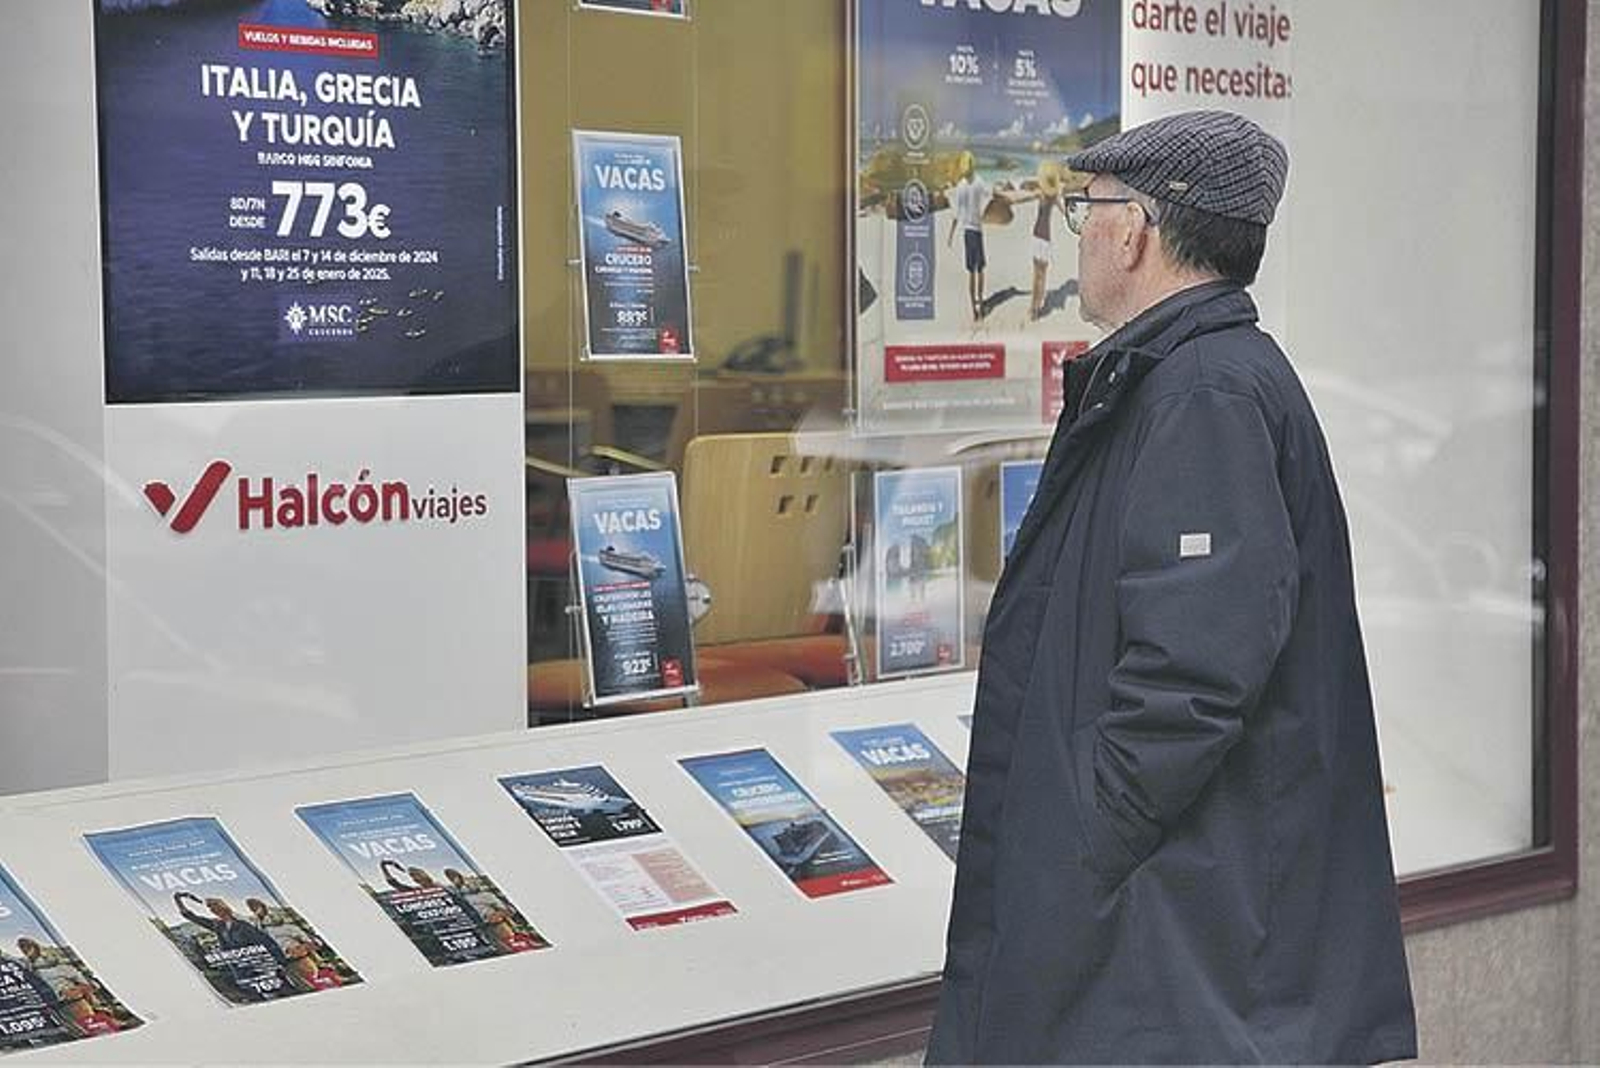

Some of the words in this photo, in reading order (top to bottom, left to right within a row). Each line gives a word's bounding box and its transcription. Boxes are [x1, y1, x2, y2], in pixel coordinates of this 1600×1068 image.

[1131, 0, 1197, 33] darte
[1205, 2, 1226, 37] el
[1234, 4, 1291, 47] viaje
[949, 54, 979, 75] 10%
[1014, 58, 1037, 78] 5%
[201, 64, 308, 107] ITALIA,
[314, 71, 422, 108] GRECIA
[1131, 62, 1178, 97] que
[232, 110, 254, 142] Y
[261, 110, 395, 149] TURQUÍA
[594, 163, 666, 191] VACAS
[229, 215, 266, 229] DESDE
[190, 247, 228, 262] Salidas
[230, 248, 263, 262] desde
[291, 249, 301, 262] el
[302, 250, 310, 262] 7
[311, 253, 318, 265] y
[321, 250, 332, 262] 14
[333, 250, 347, 263] de
[349, 249, 397, 263] diciembre
[399, 250, 412, 263] de
[413, 251, 439, 264] 2024
[240, 270, 248, 281] y
[277, 270, 285, 282] y
[287, 268, 300, 280] 25
[302, 267, 315, 280] de
[316, 270, 346, 281] enero
[347, 267, 360, 280] de
[308, 304, 353, 324] MSC
[237, 469, 410, 530] Halcón
[411, 487, 488, 524] viajes
[594, 509, 662, 533] VACAS
[860, 743, 931, 766] VACAS
[349, 833, 437, 859] VACAS
[139, 863, 238, 892] VACAS
